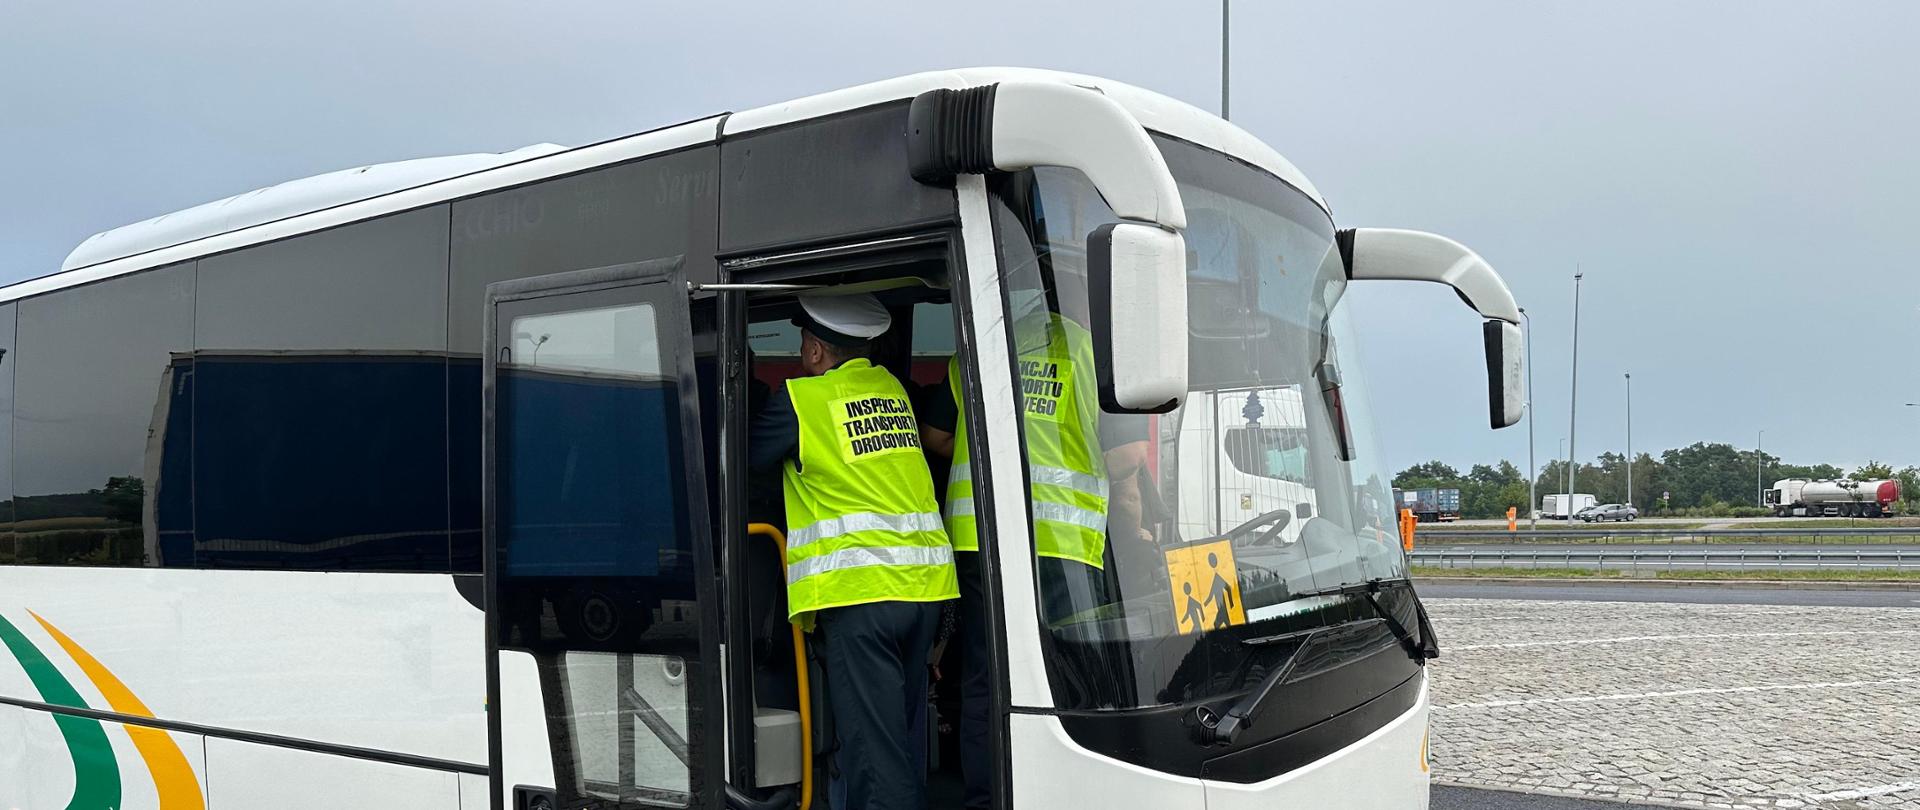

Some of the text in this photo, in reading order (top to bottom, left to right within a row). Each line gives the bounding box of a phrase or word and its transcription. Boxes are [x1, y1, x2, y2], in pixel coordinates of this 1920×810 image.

[1019, 361, 1057, 379] KCJA
[845, 397, 911, 419] INSPEKCJA
[851, 432, 920, 456] DROGOWEG
